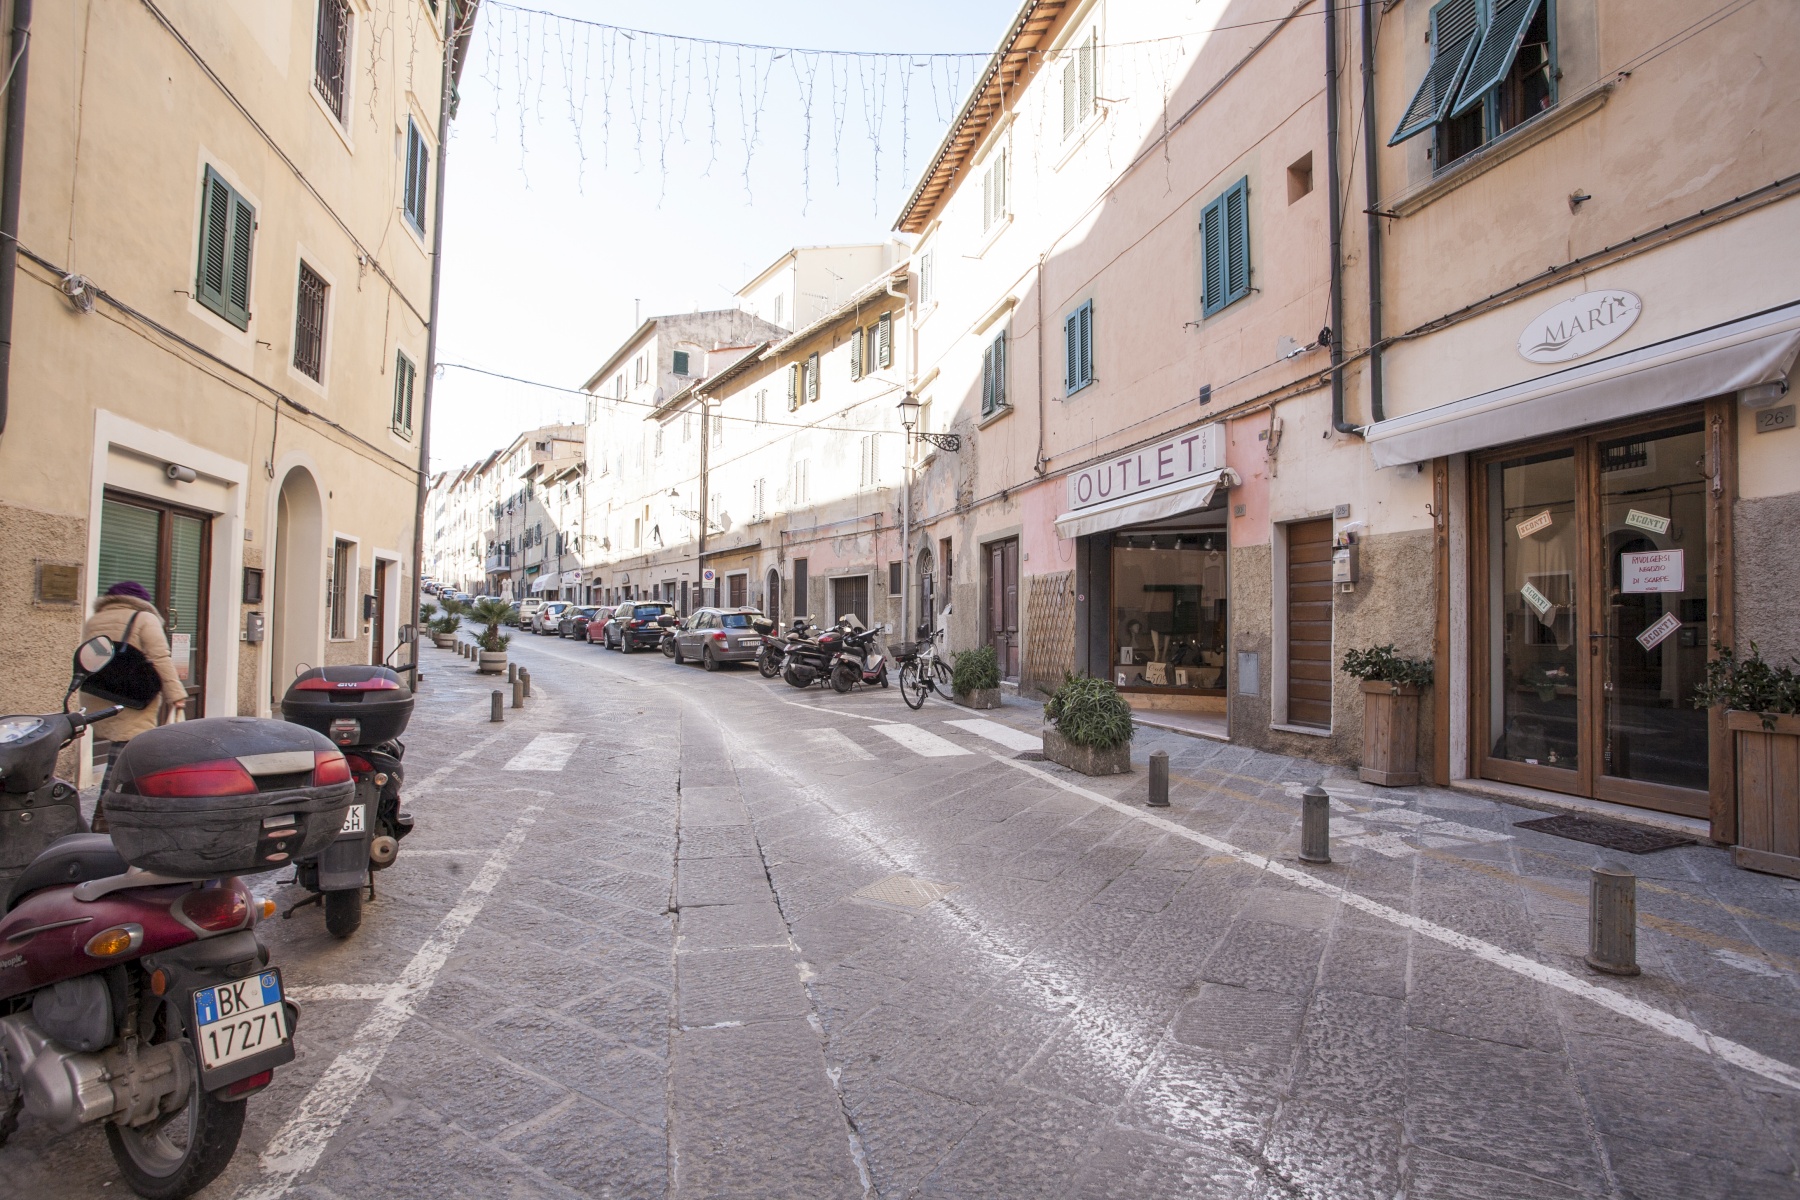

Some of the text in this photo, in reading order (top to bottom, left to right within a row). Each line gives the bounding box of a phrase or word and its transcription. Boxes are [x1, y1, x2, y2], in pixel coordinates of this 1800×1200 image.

[1077, 434, 1200, 503] OUTLET
[1520, 515, 1548, 534] SCONTI
[1630, 513, 1665, 529] SCONTI
[1525, 586, 1548, 610] SCONTI
[1643, 618, 1675, 645] SCONTI
[217, 981, 250, 1017] BK
[208, 1011, 281, 1060] 17271
